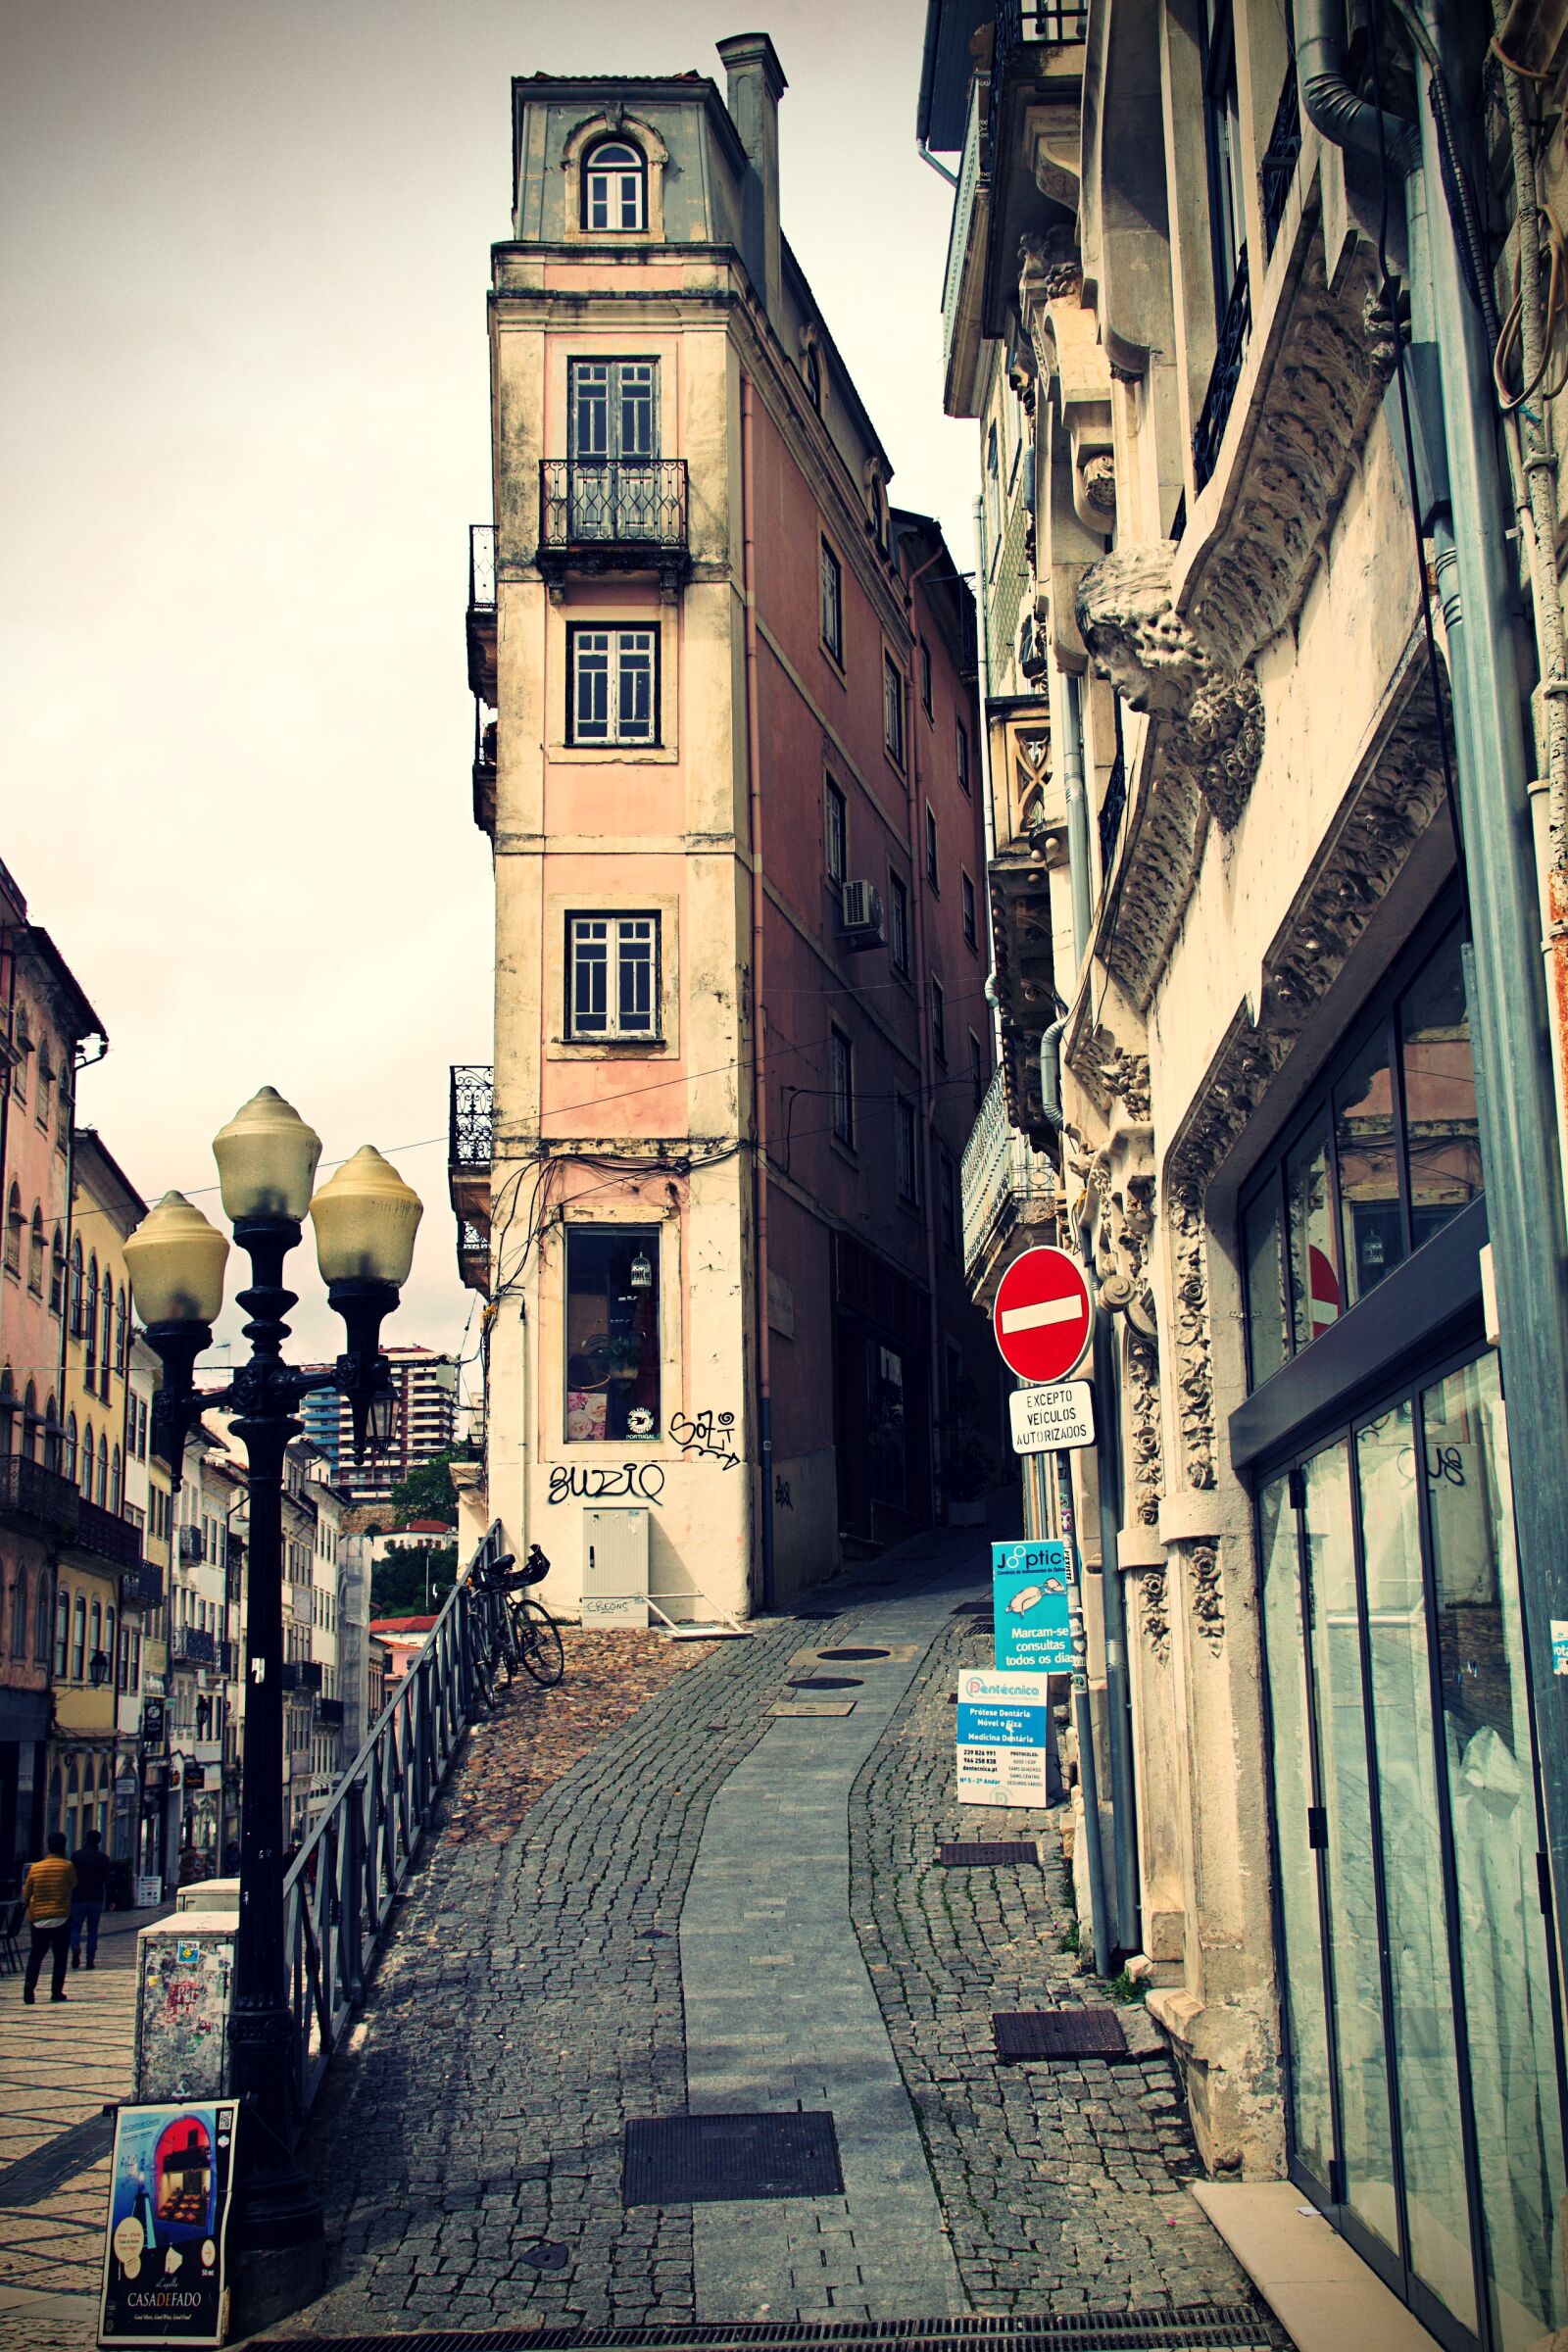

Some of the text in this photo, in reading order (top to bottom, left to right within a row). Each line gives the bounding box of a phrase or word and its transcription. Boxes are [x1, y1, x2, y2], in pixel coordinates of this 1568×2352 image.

[1027, 1390, 1073, 1408] EXCEPTO
[1016, 1424, 1087, 1446] AUTORIZADOS
[1011, 1628, 1068, 1639] Marcam-se
[1015, 1640, 1065, 1652] consultas
[1005, 1654, 1035, 1666] todos
[1038, 1655, 1052, 1664] os
[969, 1708, 1031, 1718] Prótese Dentária
[977, 1718, 999, 1727] Móvel
[968, 1733, 1001, 1741] Medicina
